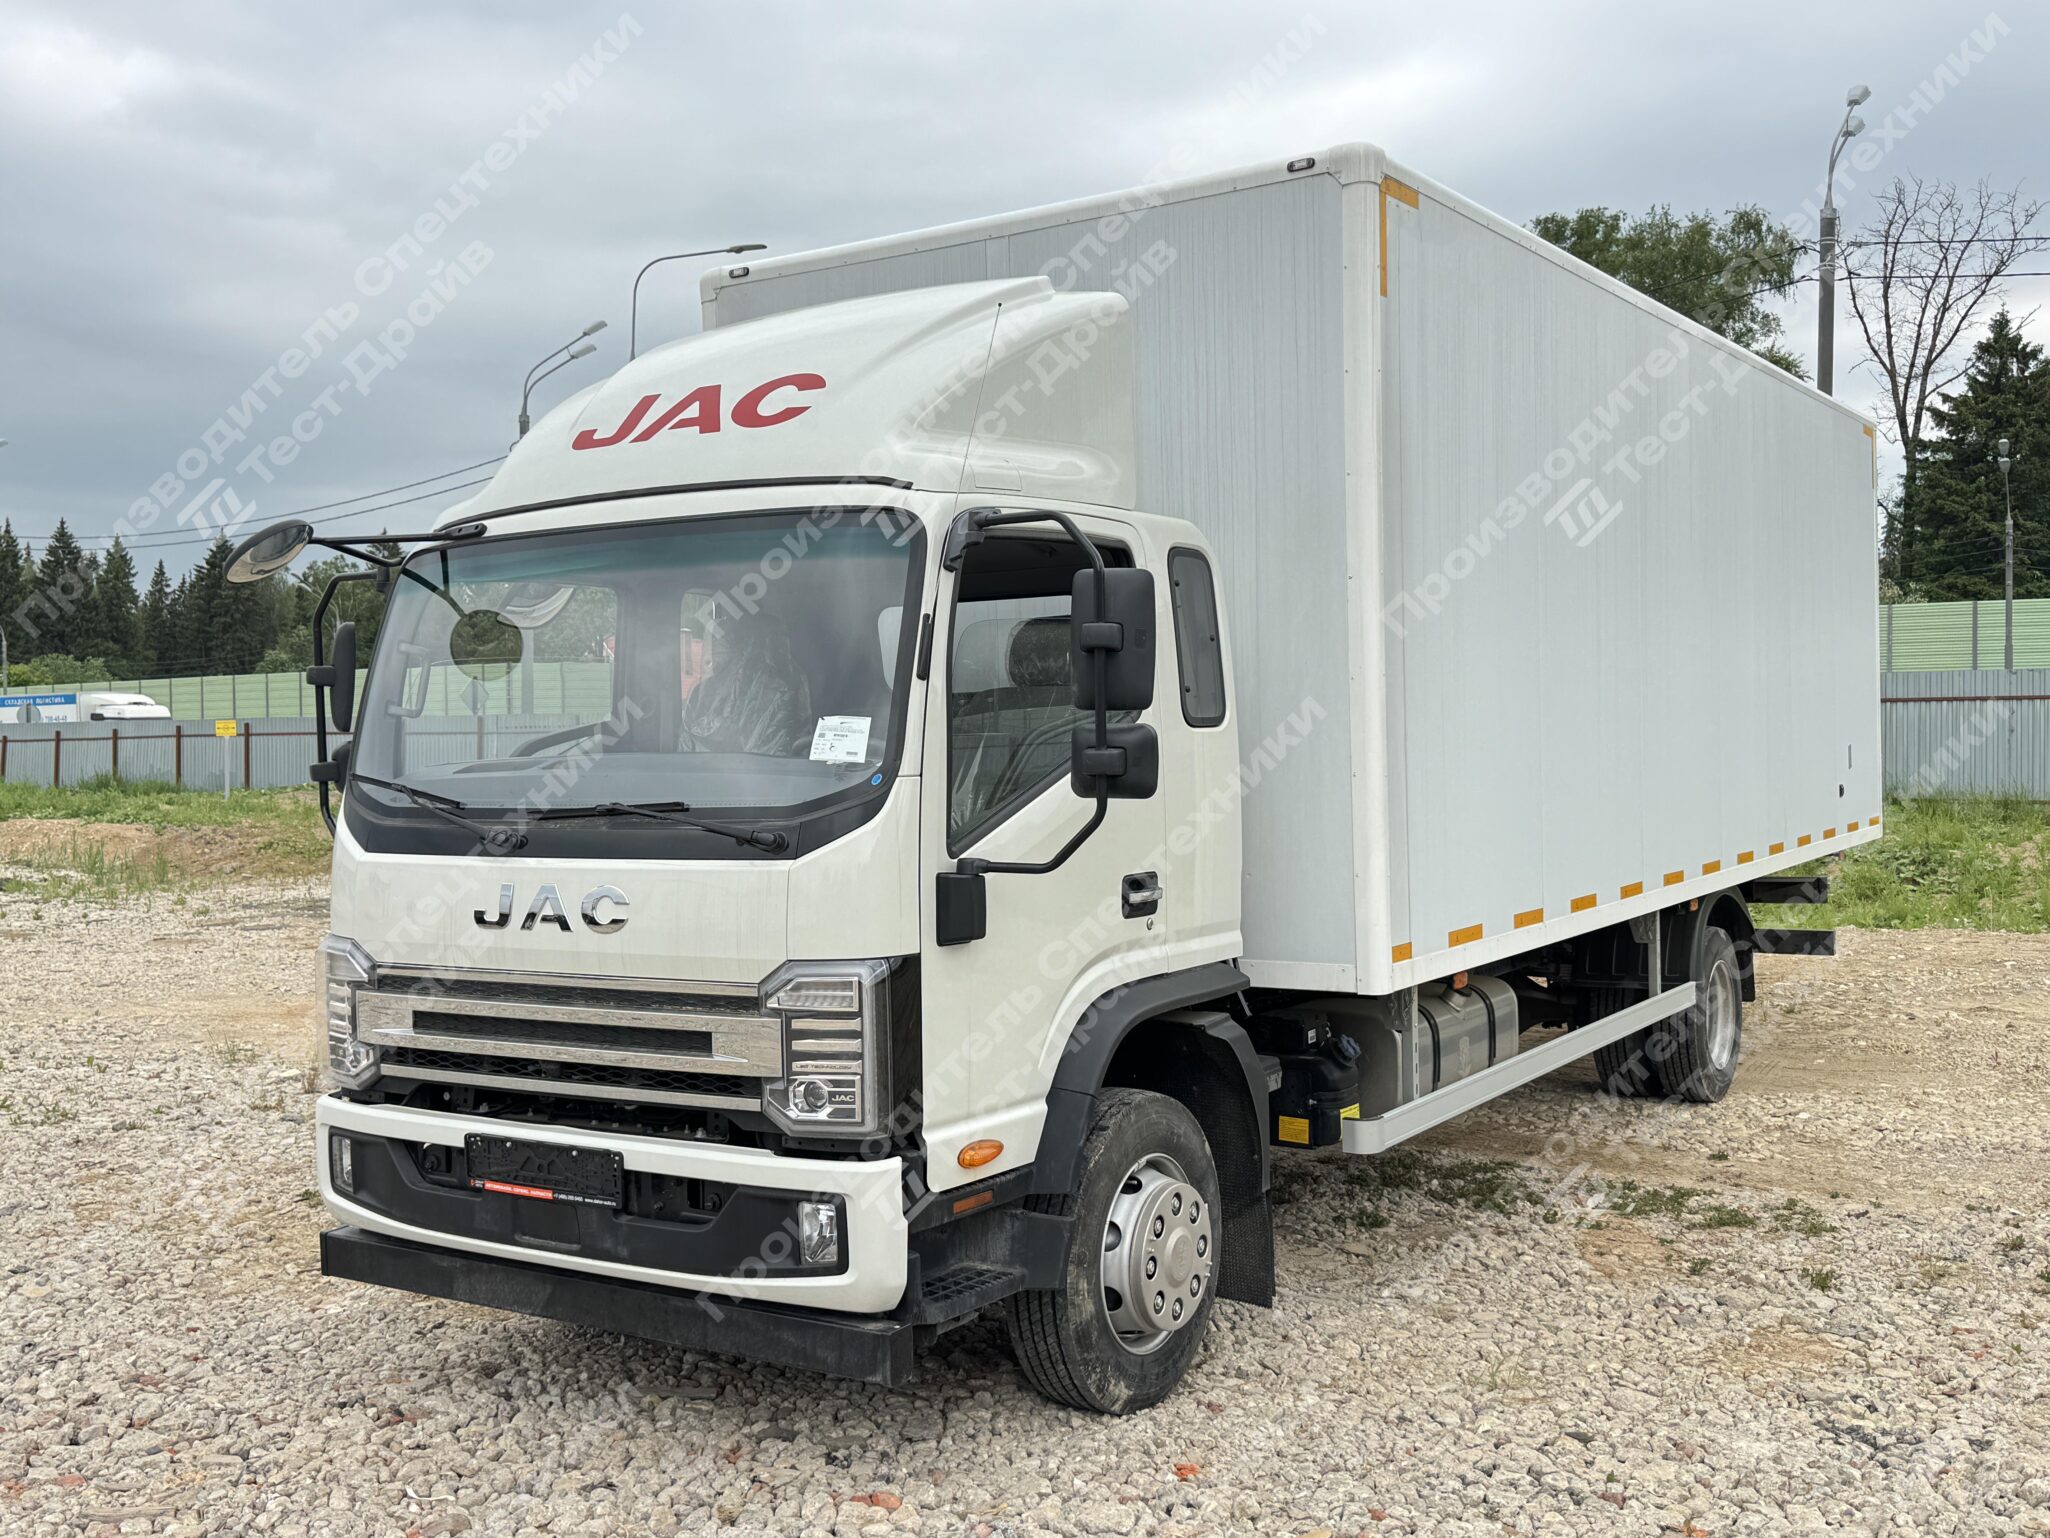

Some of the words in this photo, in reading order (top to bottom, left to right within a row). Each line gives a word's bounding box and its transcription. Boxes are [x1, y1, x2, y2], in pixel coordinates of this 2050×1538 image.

[572, 373, 826, 450] JAC
[474, 883, 630, 934] JAC
[831, 1094, 855, 1102] JAC
